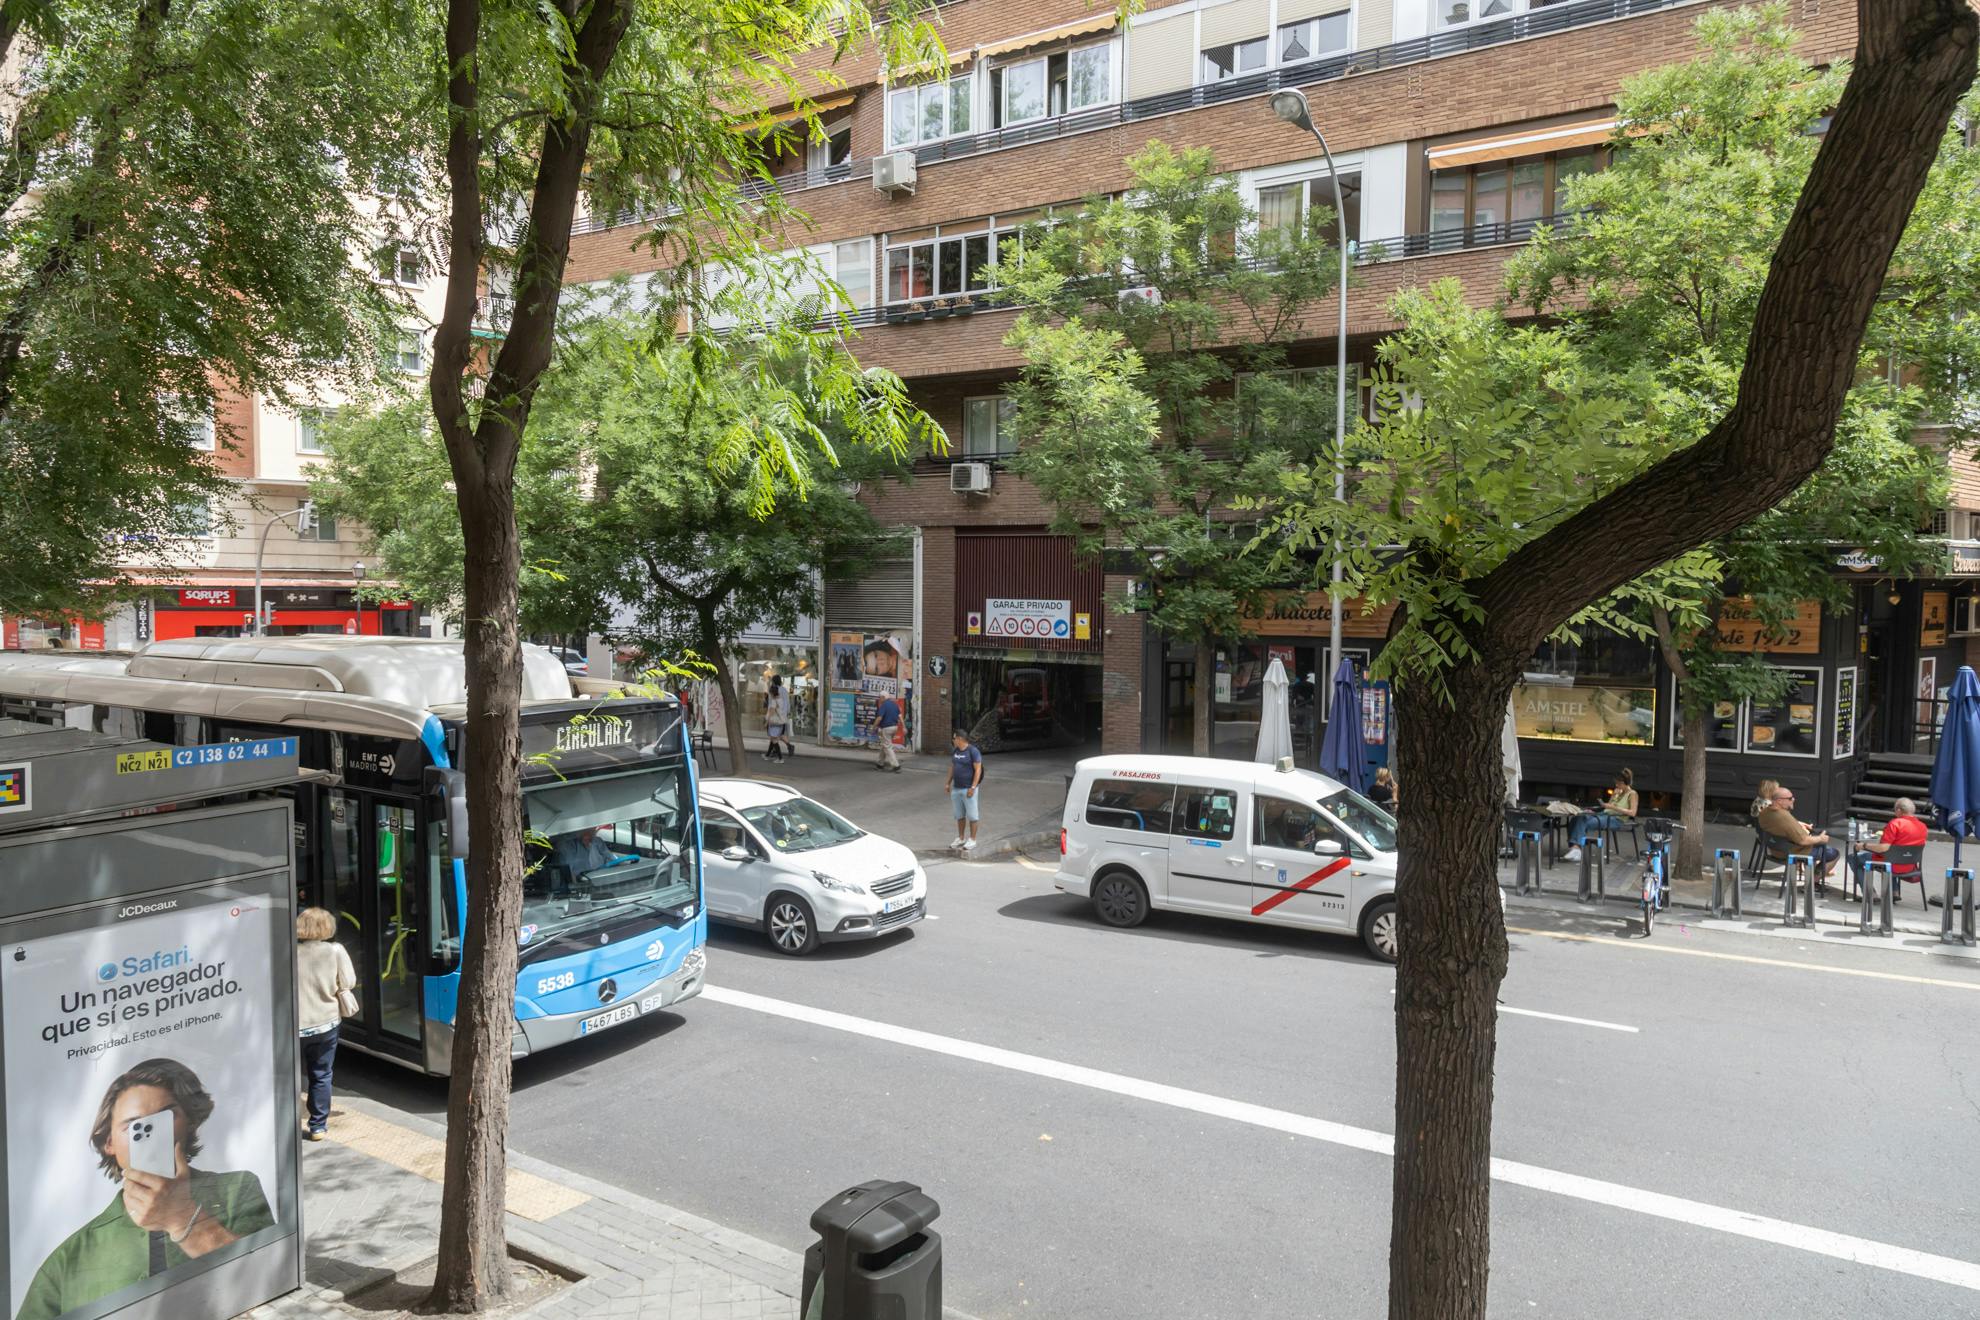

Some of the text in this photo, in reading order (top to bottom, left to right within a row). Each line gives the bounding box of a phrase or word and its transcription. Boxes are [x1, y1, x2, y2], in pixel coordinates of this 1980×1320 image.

[185, 590, 230, 601] SQRUPS
[992, 600, 1063, 610] GARAJE PRIVADO
[1266, 605, 1352, 621] Maceteo
[1525, 699, 1587, 716] AMSTEL
[556, 719, 633, 751] CIRCULAR 2
[120, 741, 287, 773] NC2 N21 C2 138 62 44 1
[349, 759, 378, 772] MADRID
[362, 752, 378, 762] EMT
[1118, 770, 1162, 780] PASAJEROS
[118, 899, 177, 919] JCDecaux
[121, 945, 194, 978] Safari.
[60, 960, 226, 1014] Un navegador
[538, 971, 575, 995] 5538
[41, 978, 243, 1043] que sí es privado.
[644, 996, 660, 1011] SP
[587, 1006, 632, 1032] 5467 LBS
[66, 1010, 223, 1060] Privacidad. Esto es el iPhone.
